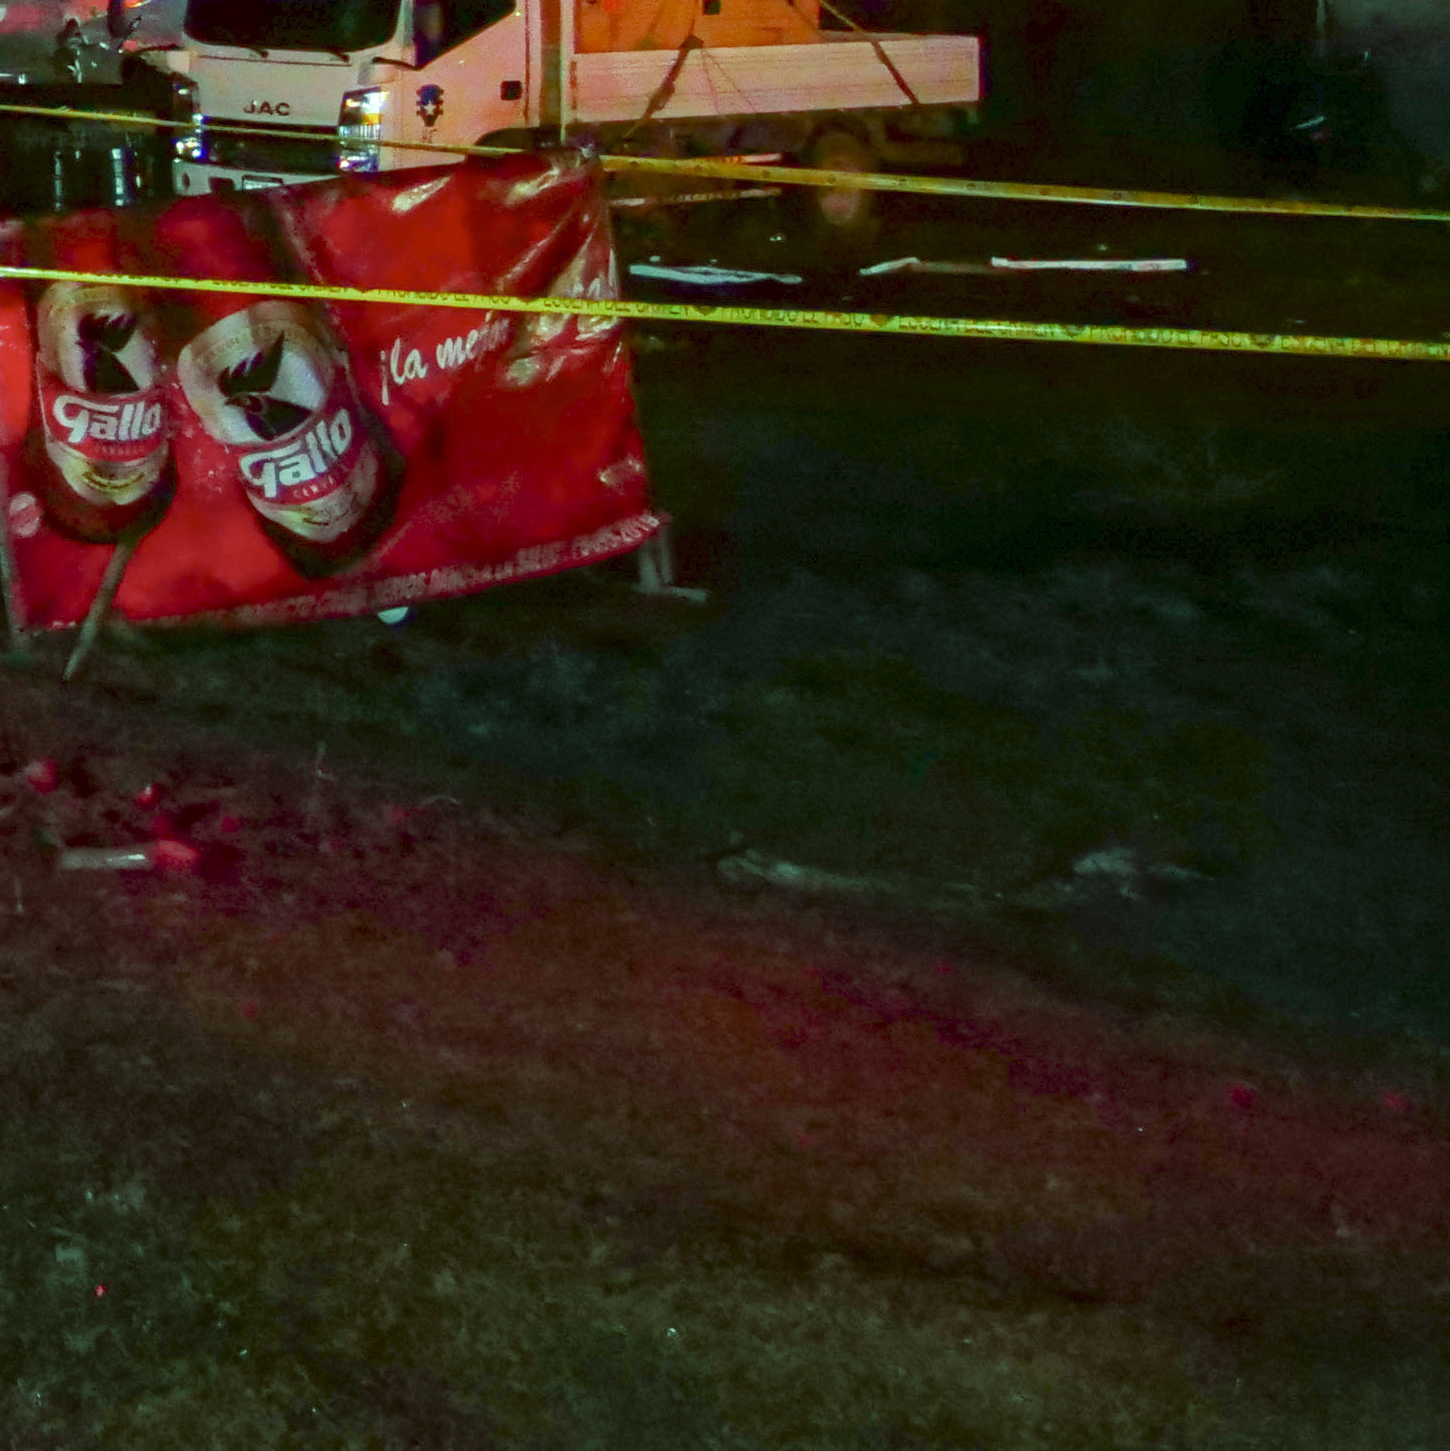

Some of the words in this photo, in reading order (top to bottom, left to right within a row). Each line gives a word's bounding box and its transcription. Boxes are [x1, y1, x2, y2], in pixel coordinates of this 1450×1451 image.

[243, 100, 291, 116] JAC
[53, 395, 161, 443] Gallo
[240, 409, 351, 498] Gallo
